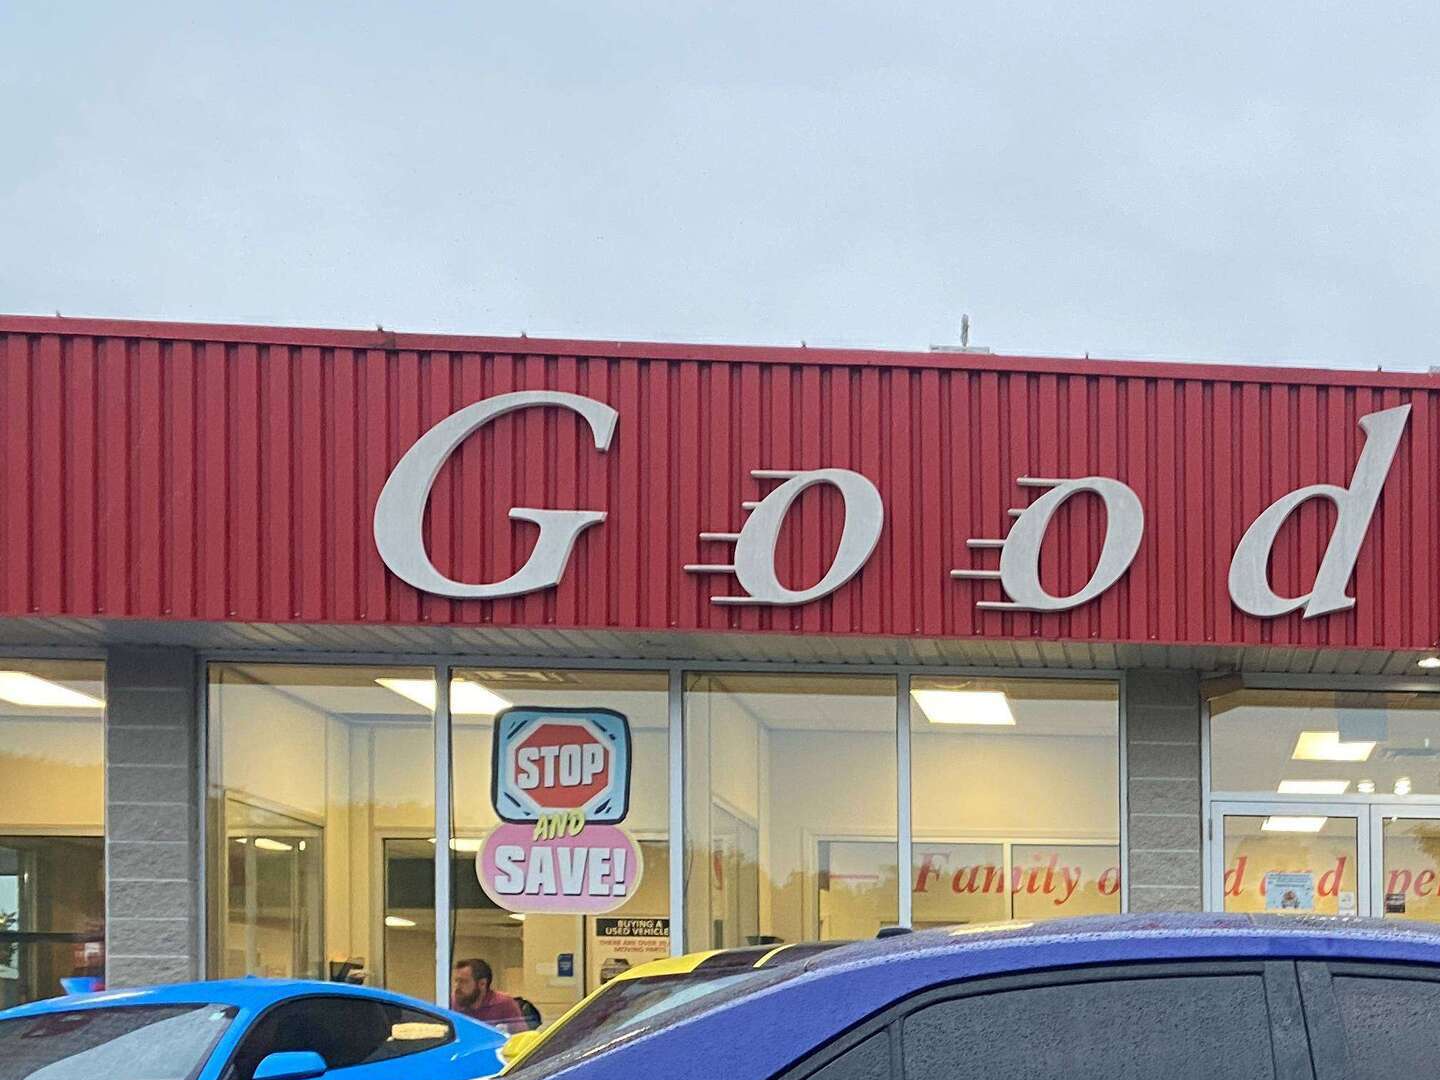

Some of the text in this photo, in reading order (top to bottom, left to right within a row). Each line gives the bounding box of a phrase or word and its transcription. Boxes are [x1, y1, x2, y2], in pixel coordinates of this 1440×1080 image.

[516, 742, 605, 791] STOP
[532, 810, 587, 842] AND
[494, 845, 628, 897] SAVE!
[913, 852, 1081, 906] Family
[605, 927, 669, 936] USED VEHICLE
[617, 919, 664, 928] BUYING A
